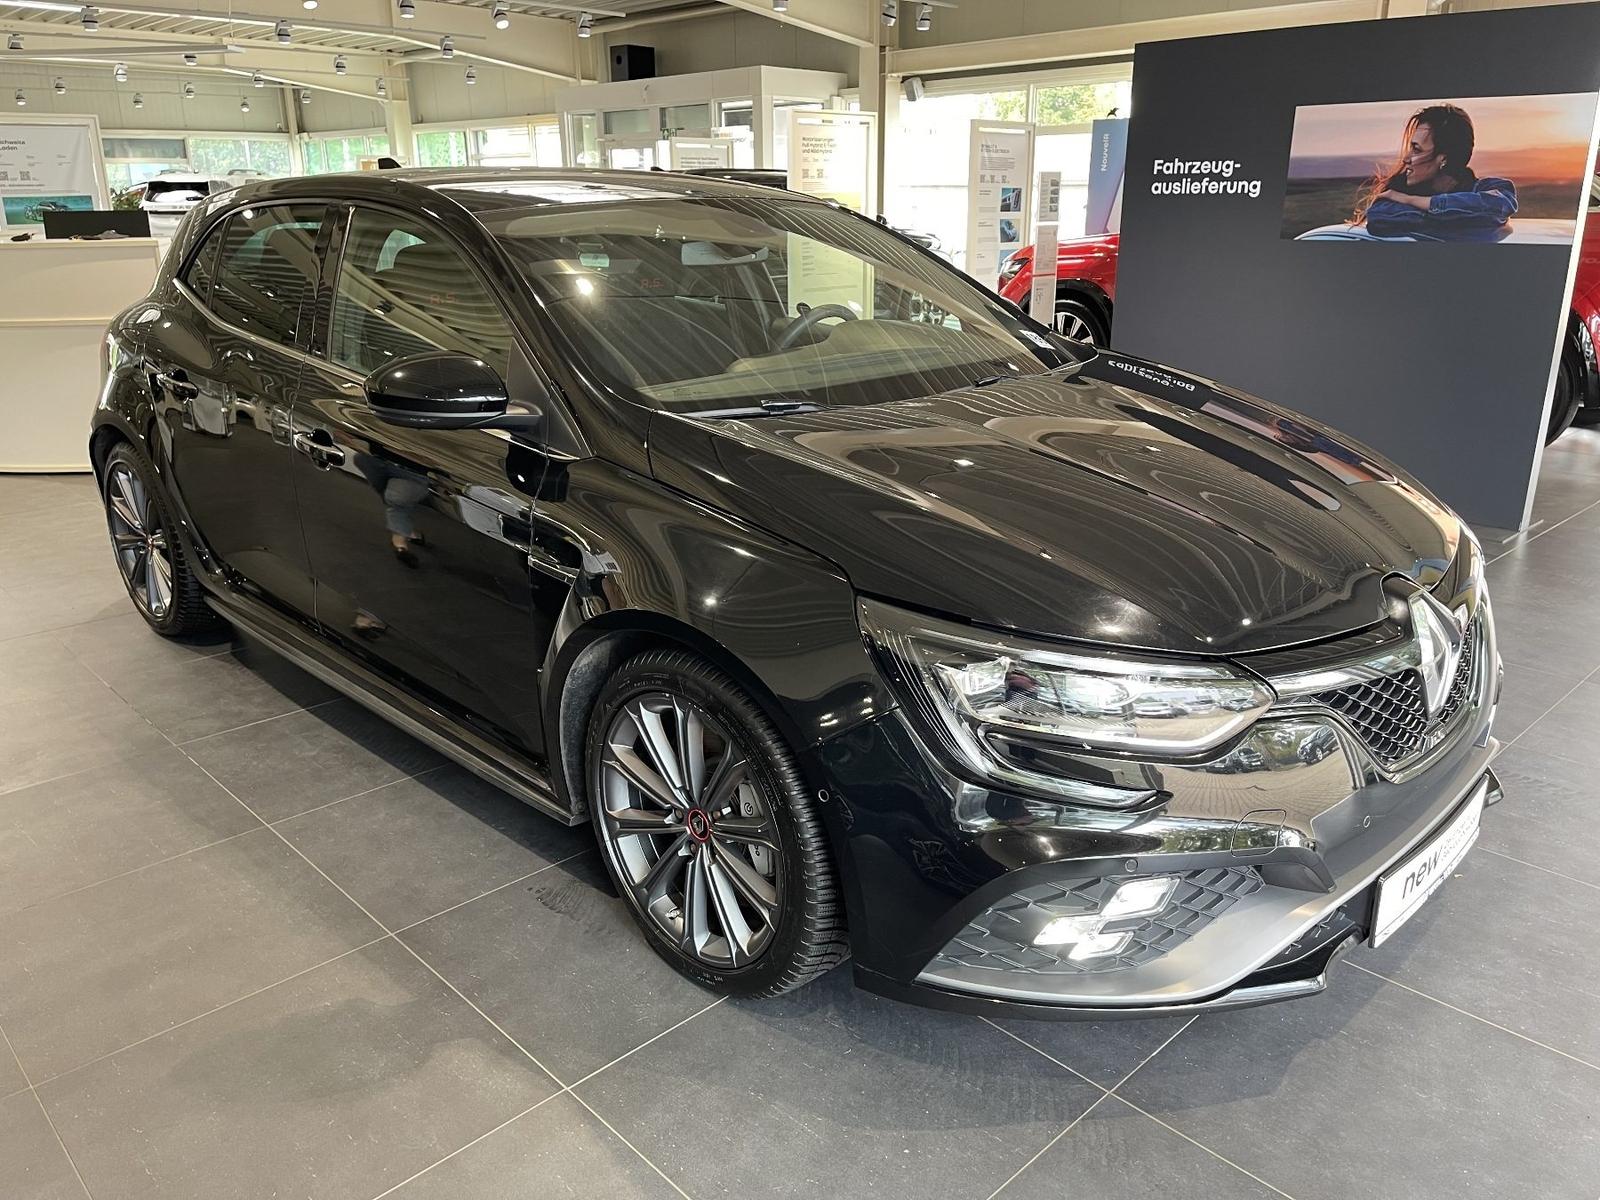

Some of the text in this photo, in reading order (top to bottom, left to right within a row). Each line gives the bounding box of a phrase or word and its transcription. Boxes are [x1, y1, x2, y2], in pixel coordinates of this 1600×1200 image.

[1153, 158, 1241, 177] Fahrzeug-
[1151, 178, 1261, 198] auslieferung
[1402, 847, 1442, 900] new
